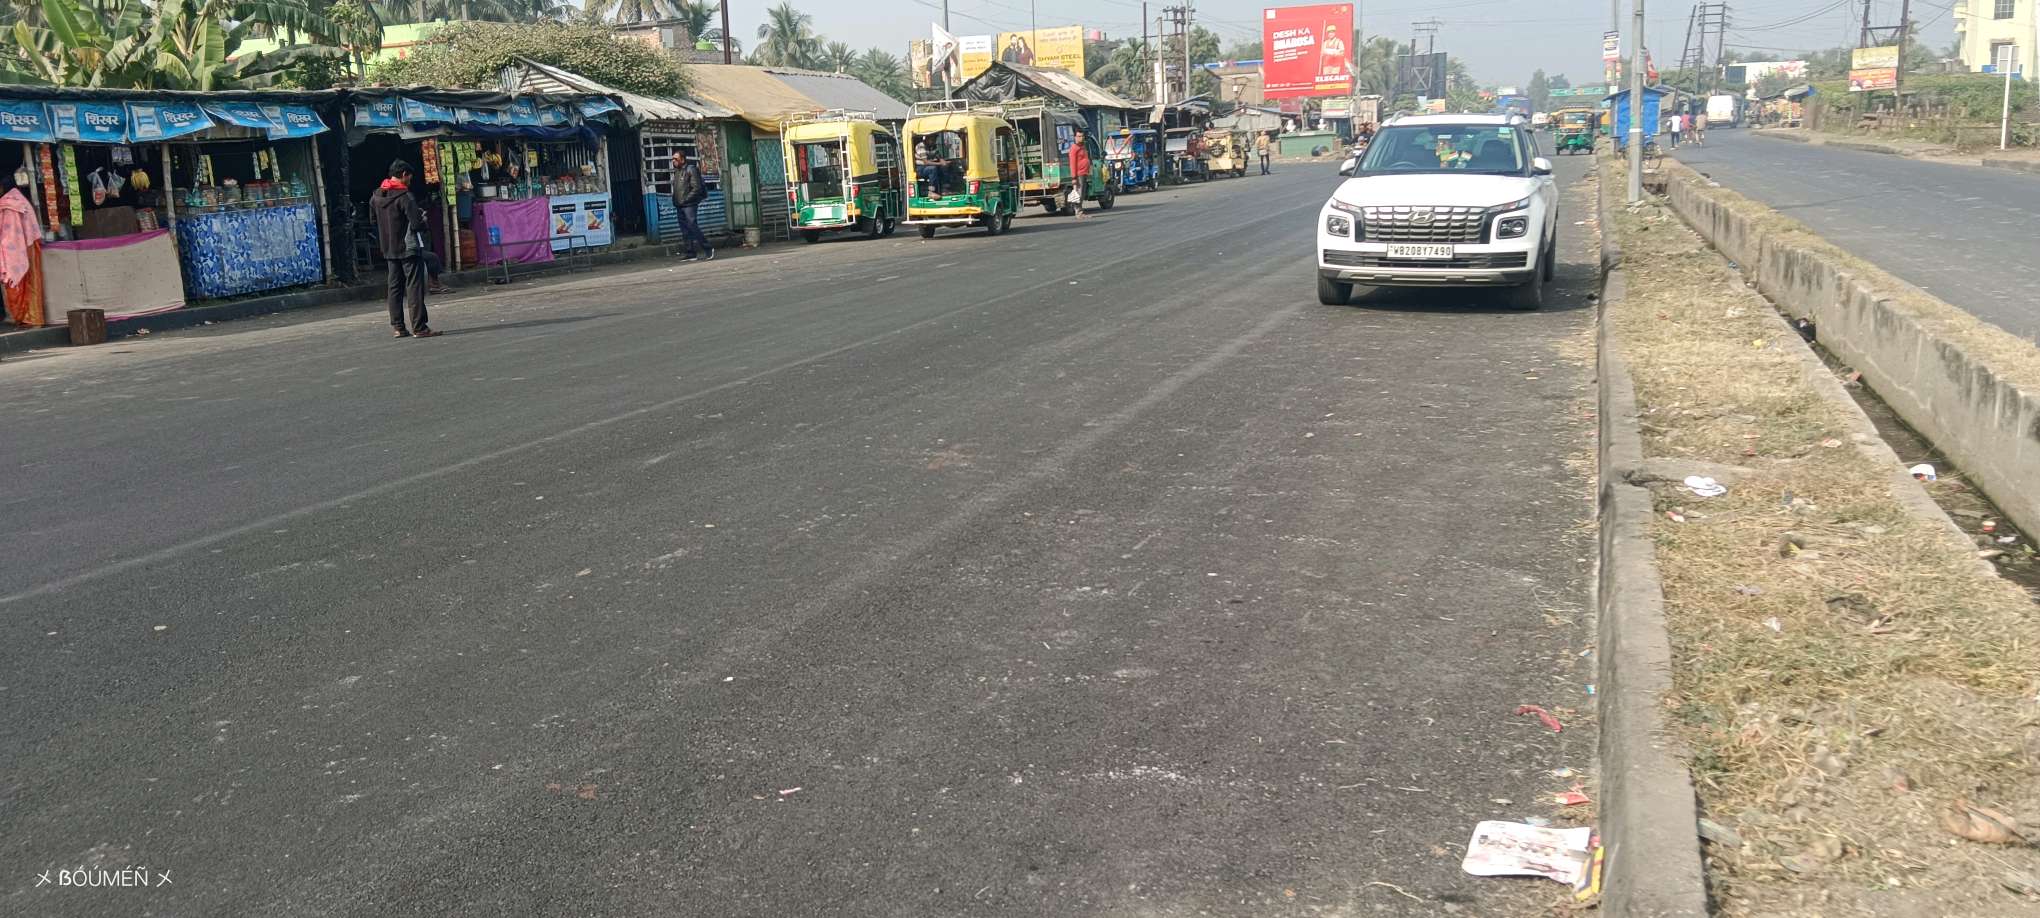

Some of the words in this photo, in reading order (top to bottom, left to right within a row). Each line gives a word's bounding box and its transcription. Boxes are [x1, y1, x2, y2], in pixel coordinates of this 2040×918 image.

[1273, 29, 1296, 39] DESH
[1298, 27, 1310, 36] KA
[1, 111, 40, 125] शिखर
[85, 111, 119, 125] शिखर
[163, 111, 197, 124] शिखर
[286, 112, 315, 124] शिखर
